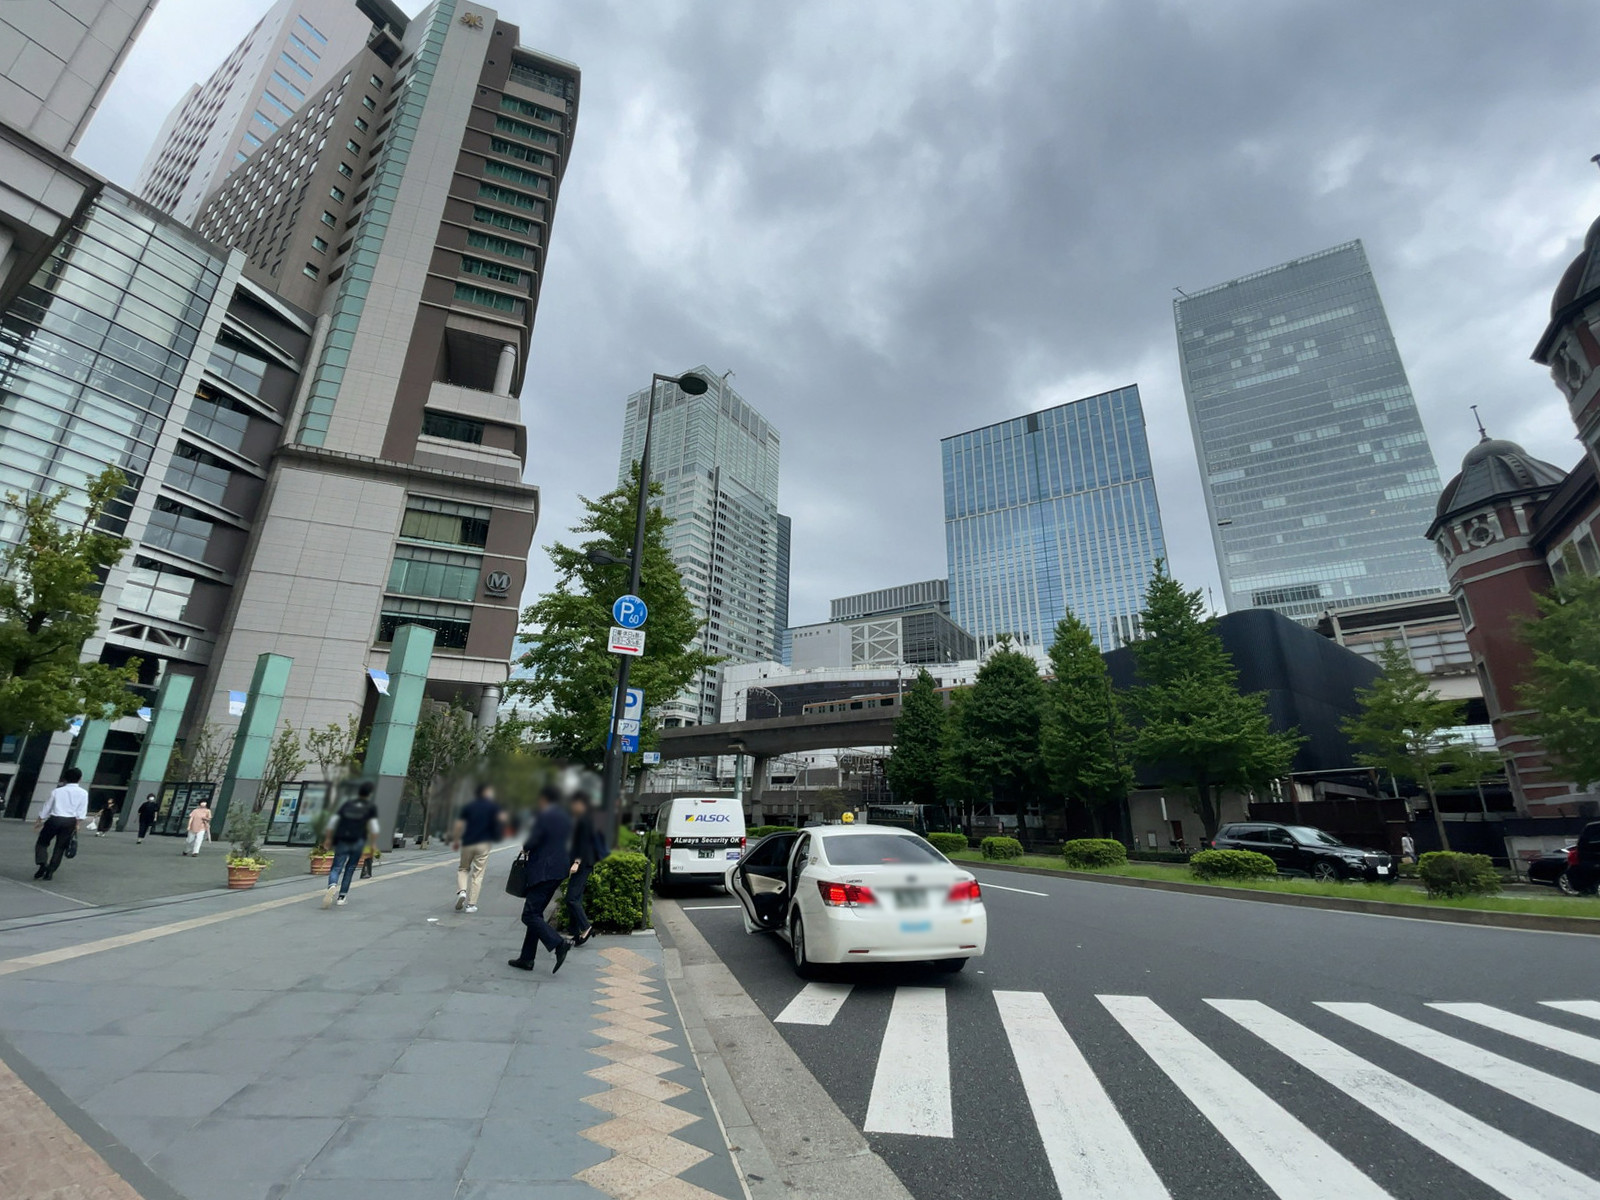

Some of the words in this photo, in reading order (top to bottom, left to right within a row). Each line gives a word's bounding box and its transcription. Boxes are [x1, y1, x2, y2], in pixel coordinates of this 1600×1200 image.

[620, 602, 635, 622] P
[628, 614, 640, 624] 60
[695, 814, 730, 822] ALSOK
